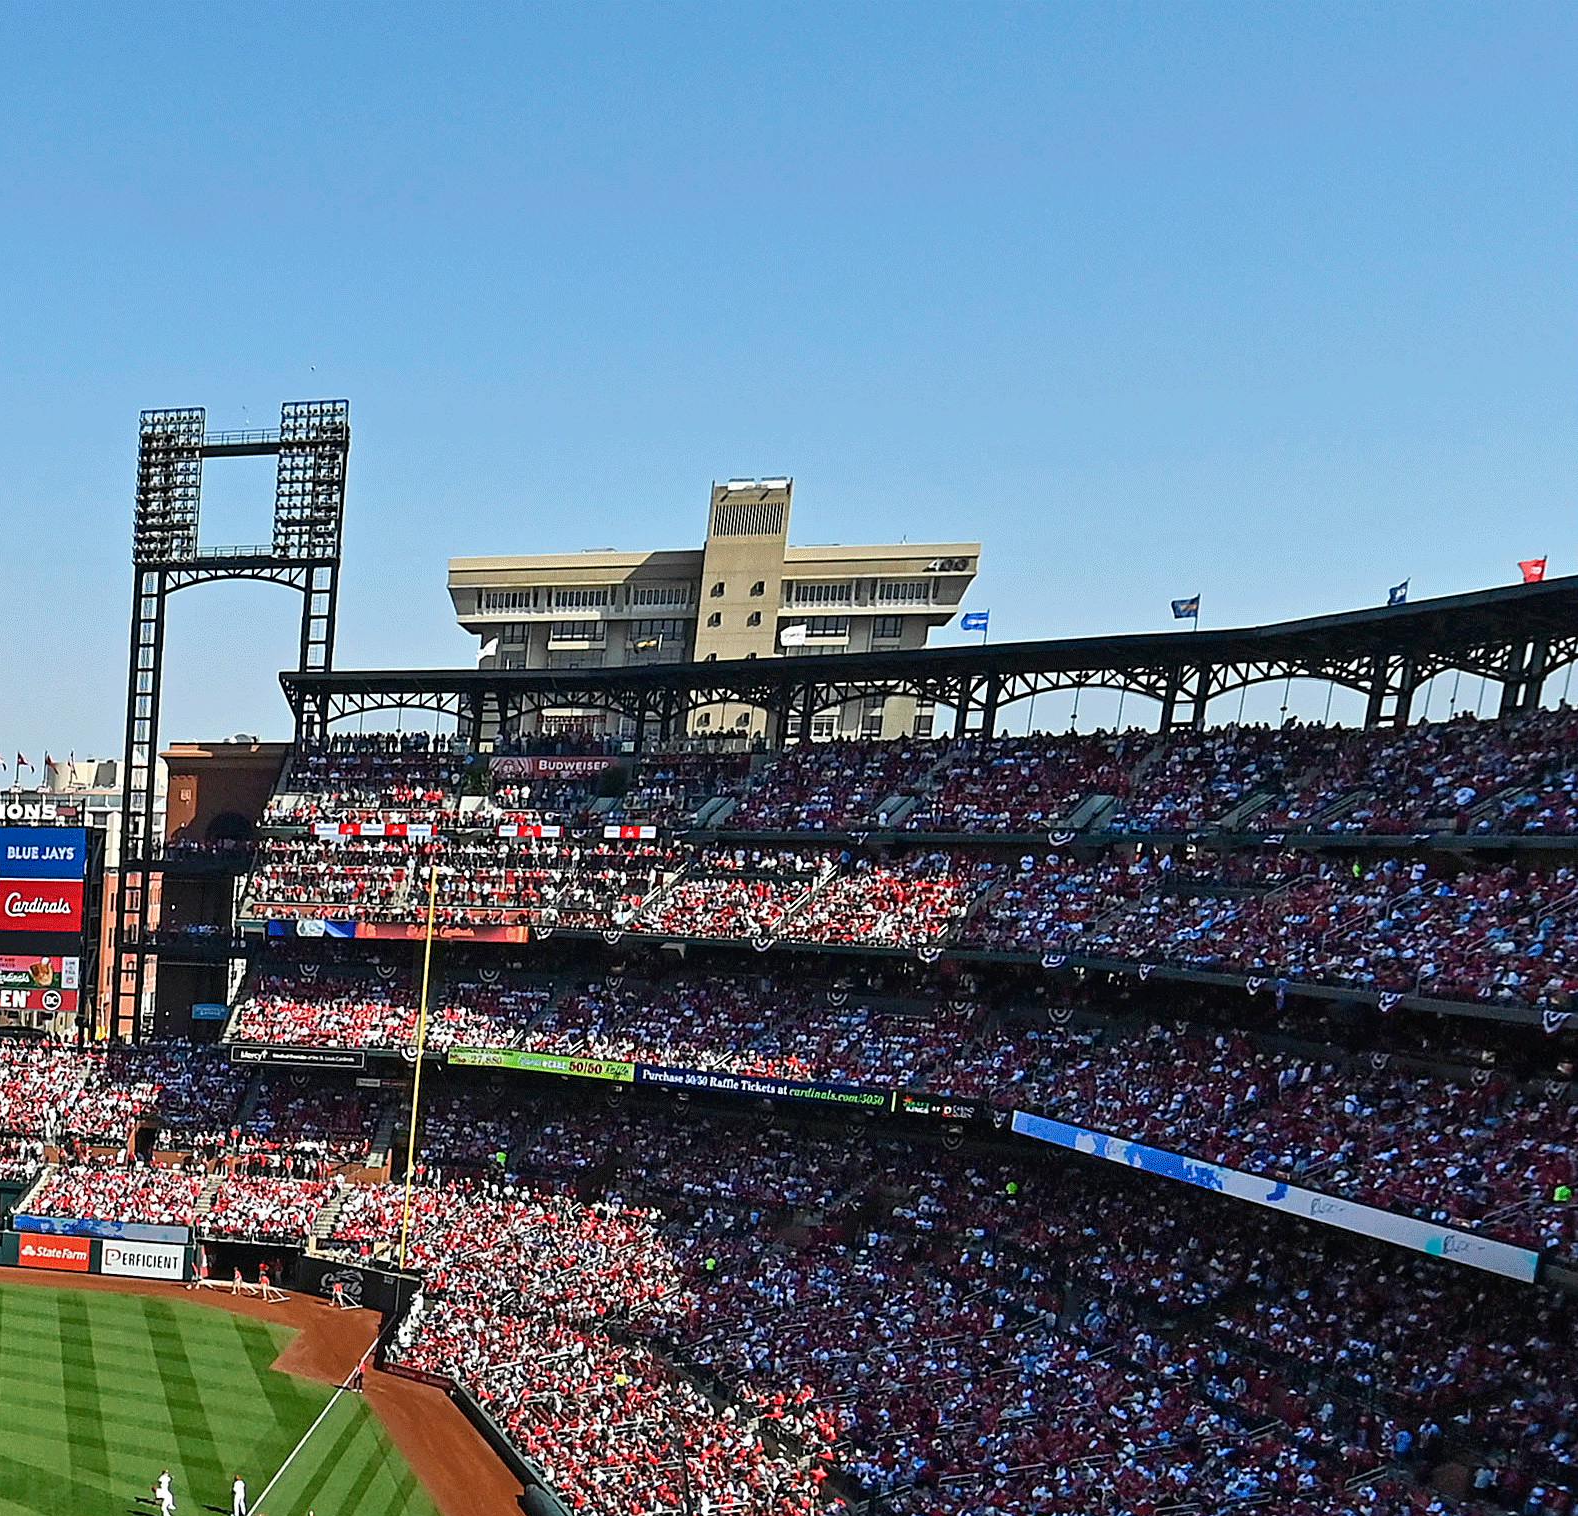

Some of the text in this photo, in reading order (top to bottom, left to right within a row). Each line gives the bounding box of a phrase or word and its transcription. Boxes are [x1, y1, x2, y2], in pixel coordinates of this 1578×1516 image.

[538, 760, 609, 772] BUDWEISER
[7, 846, 74, 860] BLUE JAYS
[4, 892, 72, 918] Cardinals
[568, 1062, 603, 1075] 50/50
[604, 1064, 630, 1079] Raffle
[643, 1069, 683, 1085] Purchase
[709, 1076, 739, 1090] Raffle
[741, 1080, 775, 1094] Tickets
[777, 1084, 788, 1095] at
[789, 1088, 884, 1106] cardinals.com/5050
[36, 1247, 88, 1262] State Farm
[105, 1248, 179, 1270] PERFICIENT
